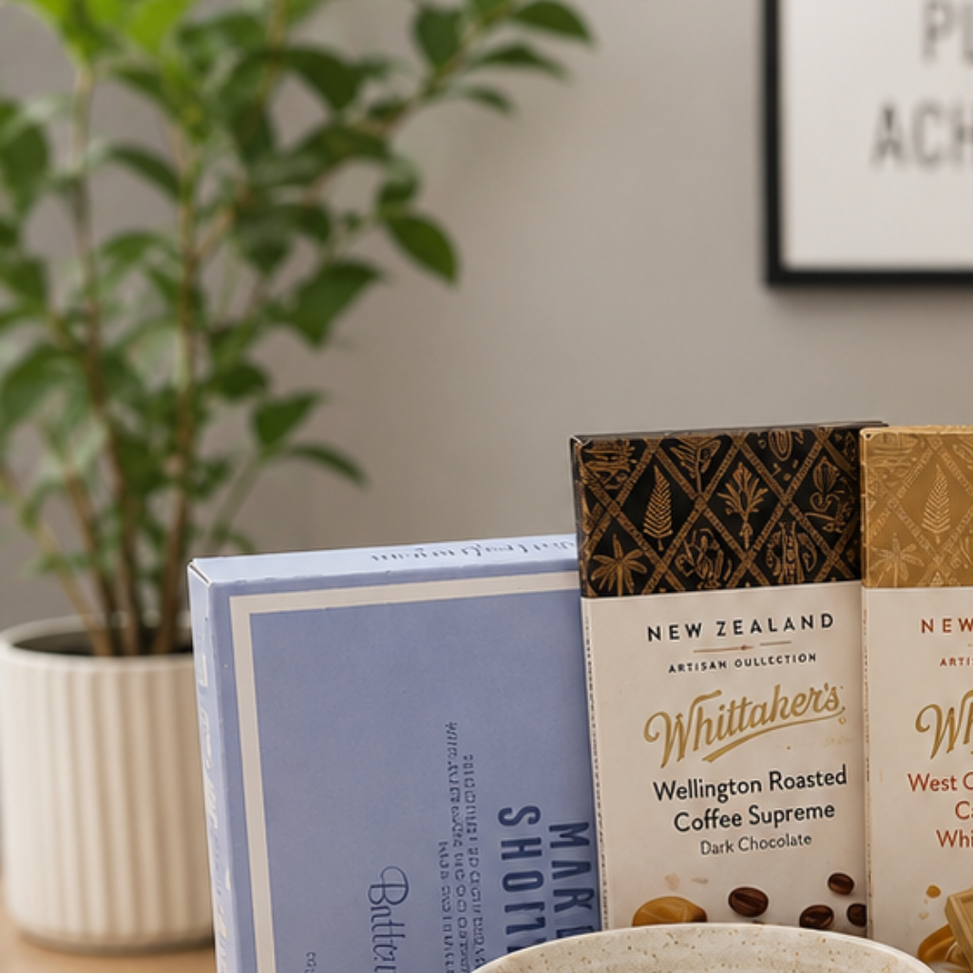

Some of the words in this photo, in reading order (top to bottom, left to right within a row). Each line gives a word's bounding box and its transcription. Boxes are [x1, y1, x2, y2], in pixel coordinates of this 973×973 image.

[647, 622, 702, 642] NEW
[716, 613, 834, 636] ZEALAND
[668, 659, 727, 674] ARTISAN
[653, 777, 762, 803] Wellington
[769, 764, 848, 791] Roasted
[907, 772, 958, 792] West
[673, 808, 743, 833] Coffee
[748, 803, 836, 829] Supreme
[700, 840, 734, 856] Dark
[738, 833, 812, 852] Chocolate
